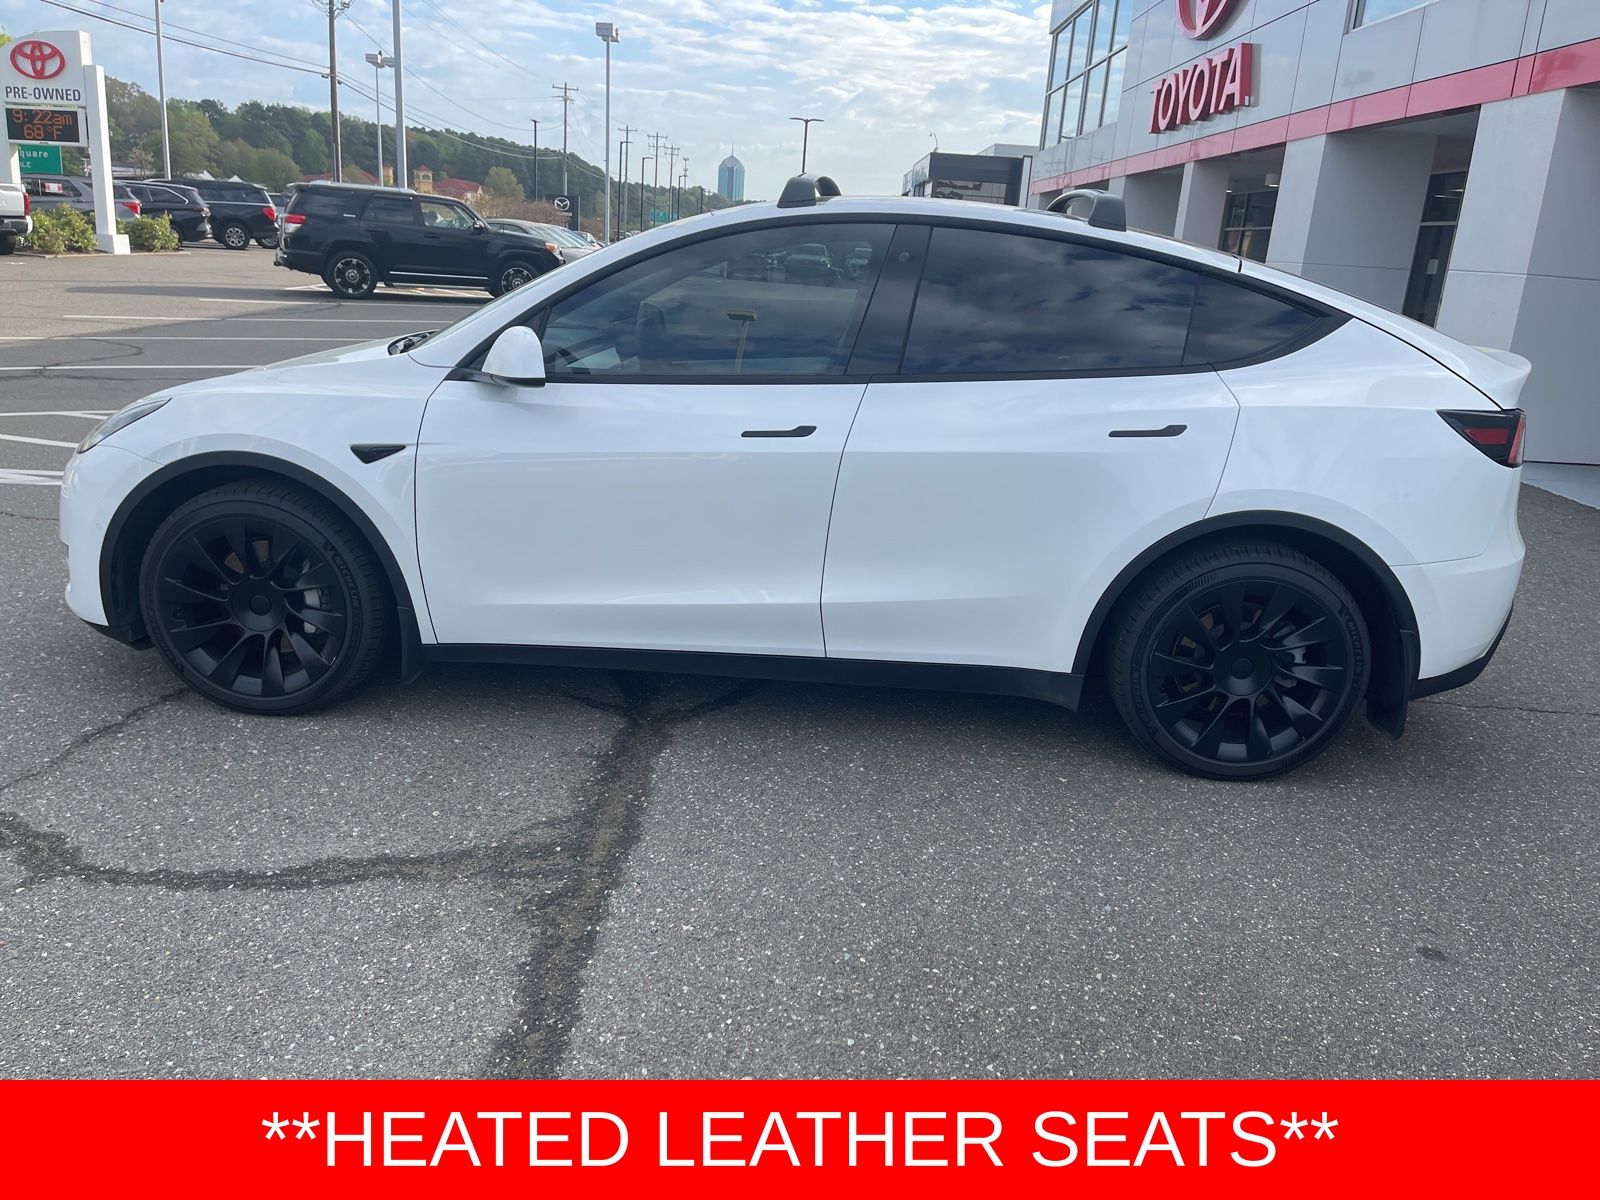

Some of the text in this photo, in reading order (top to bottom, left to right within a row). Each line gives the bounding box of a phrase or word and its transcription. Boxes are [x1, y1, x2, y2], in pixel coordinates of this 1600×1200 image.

[5, 86, 81, 101] PRE-OWNED
[1149, 43, 1252, 134] TOYOTA
[19, 150, 49, 159] quare
